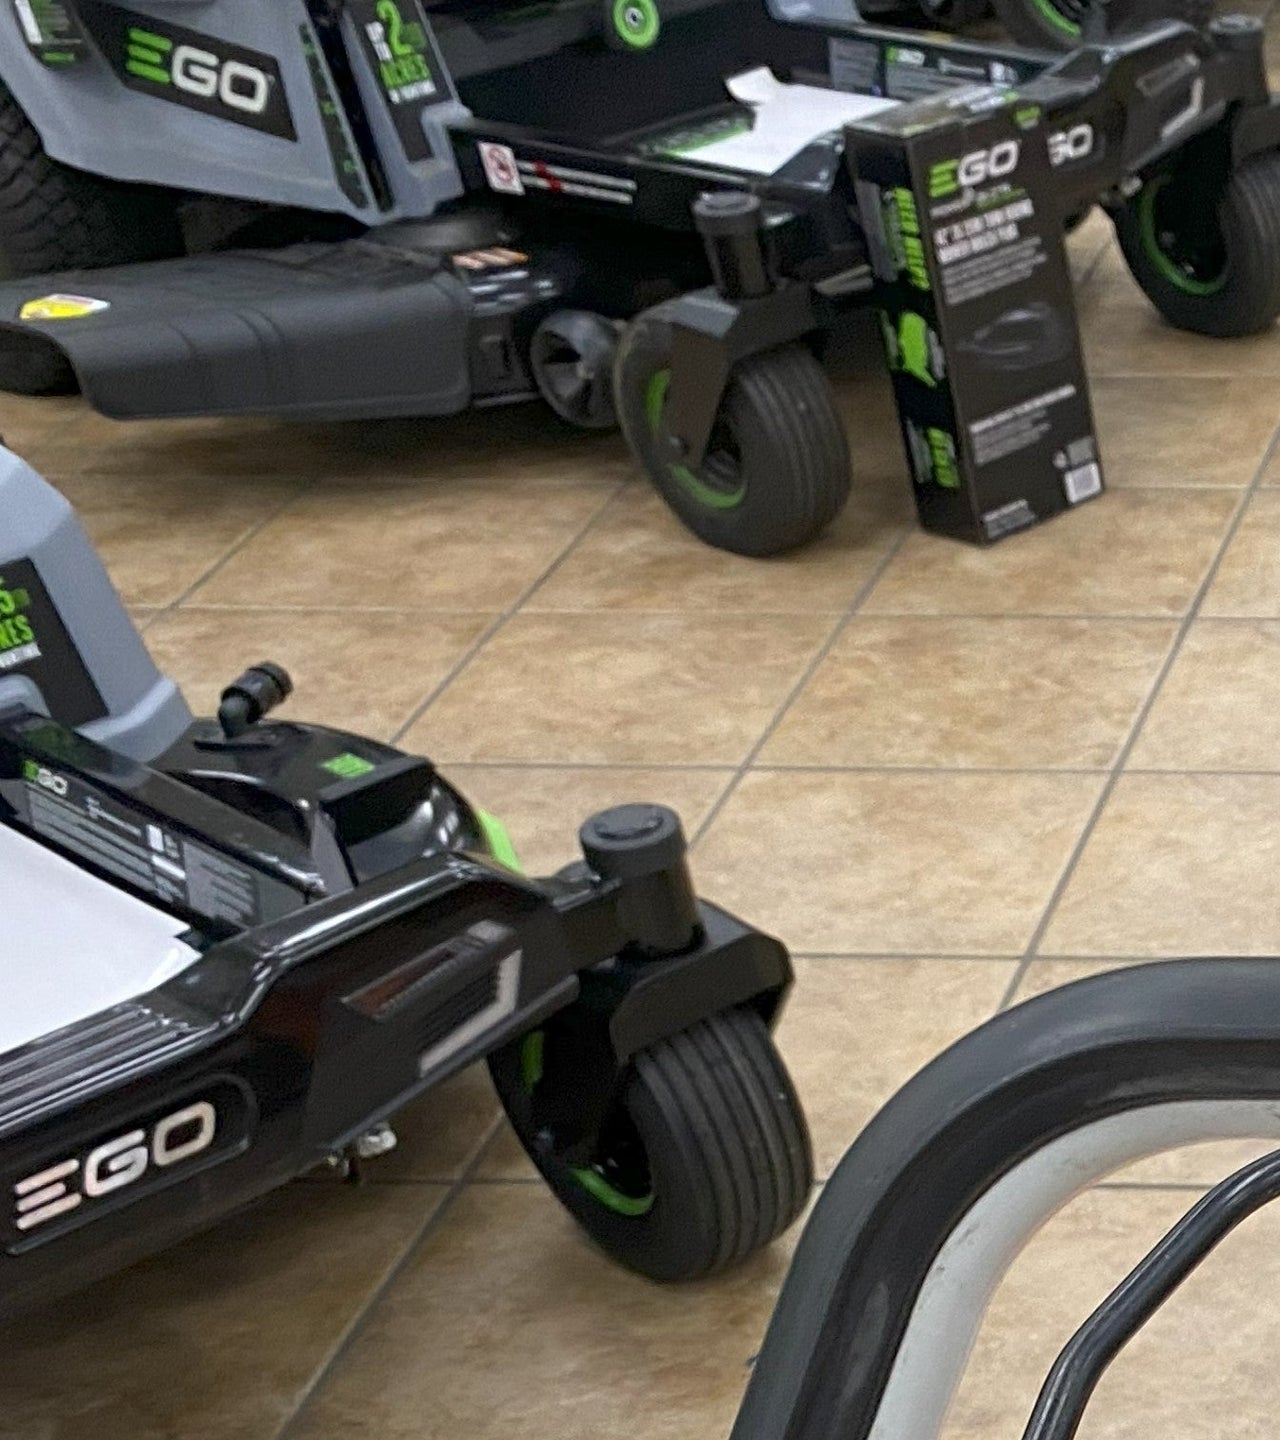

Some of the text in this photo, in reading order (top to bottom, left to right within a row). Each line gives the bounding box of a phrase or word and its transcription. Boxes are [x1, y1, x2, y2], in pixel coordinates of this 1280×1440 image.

[126, 28, 269, 113] EGO
[929, 140, 1020, 198] EGO
[15, 1101, 217, 1230] EGO
